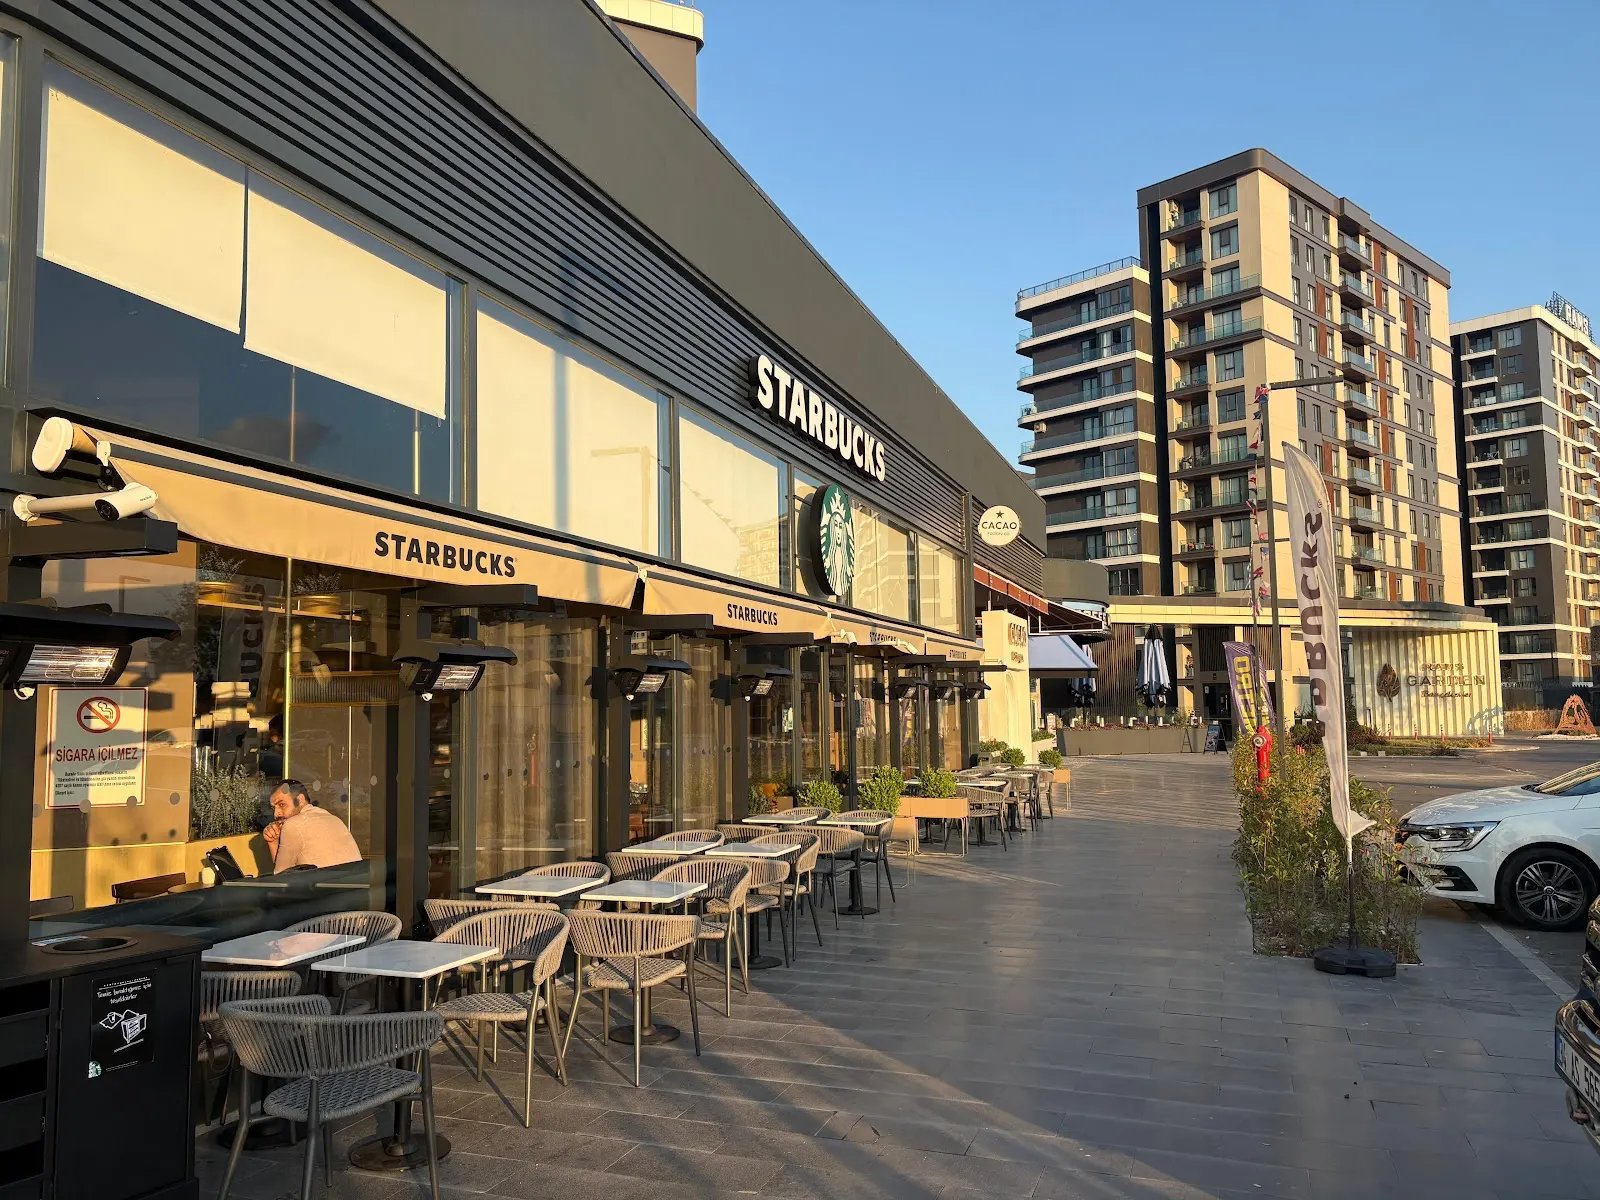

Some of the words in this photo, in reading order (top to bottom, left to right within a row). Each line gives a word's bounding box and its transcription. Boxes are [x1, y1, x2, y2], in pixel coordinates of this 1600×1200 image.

[757, 355, 886, 481] STARBUCKS
[981, 521, 1018, 530] CACAO
[374, 531, 516, 578] STARBUCKS
[727, 603, 778, 626] STARBUCKS
[1407, 675, 1486, 687] GARDEN
[55, 745, 96, 762] SİGARA
[98, 744, 138, 763] İÇİLMEZ
